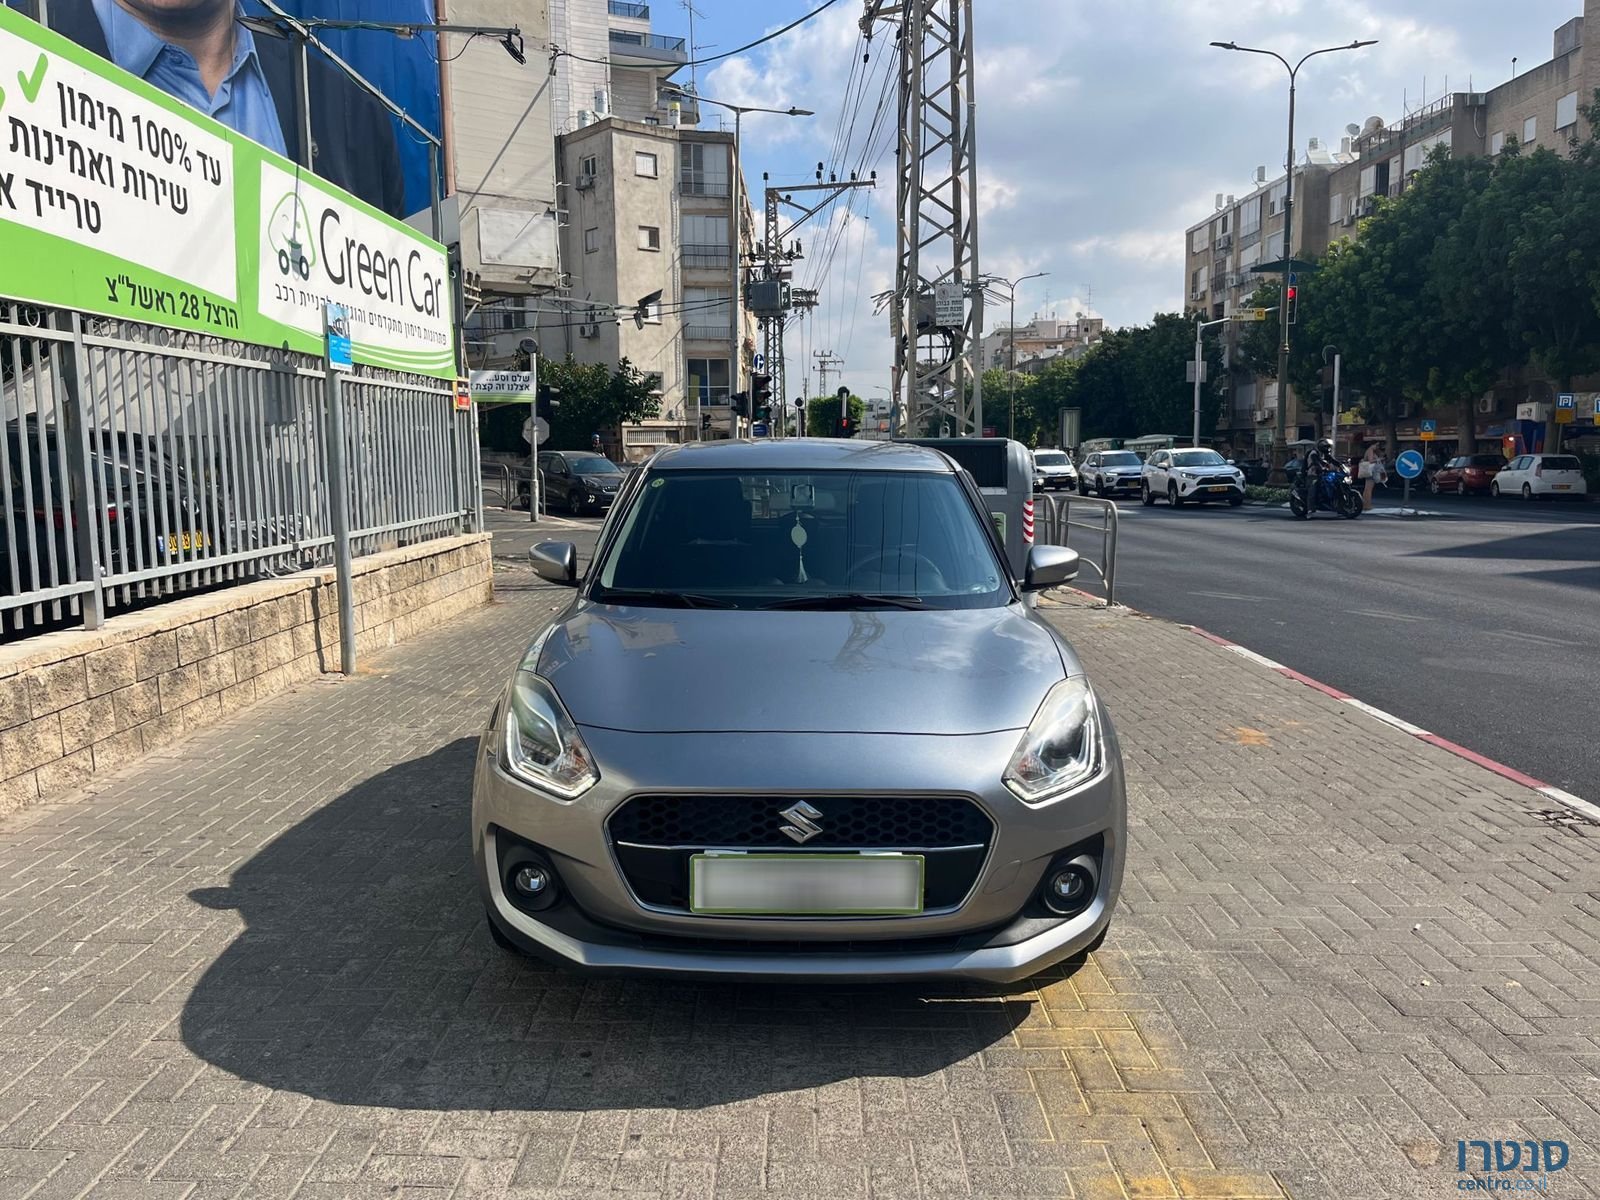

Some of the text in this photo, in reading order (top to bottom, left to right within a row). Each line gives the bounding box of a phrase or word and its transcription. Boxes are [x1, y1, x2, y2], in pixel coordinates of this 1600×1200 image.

[57, 81, 222, 186] עד 100% מימון
[8, 115, 188, 215] שירות ואמינות
[25, 178, 102, 234] טרייד
[320, 208, 442, 318] Green Car
[180, 291, 200, 320] 28
[275, 283, 296, 304] רכב
[203, 295, 239, 329] הרצל
[368, 312, 403, 334] מתקדמים
[404, 322, 422, 339] מימון
[475, 383, 493, 391] קצת
[507, 382, 530, 391] אצלנו
[511, 374, 530, 382] שלם
